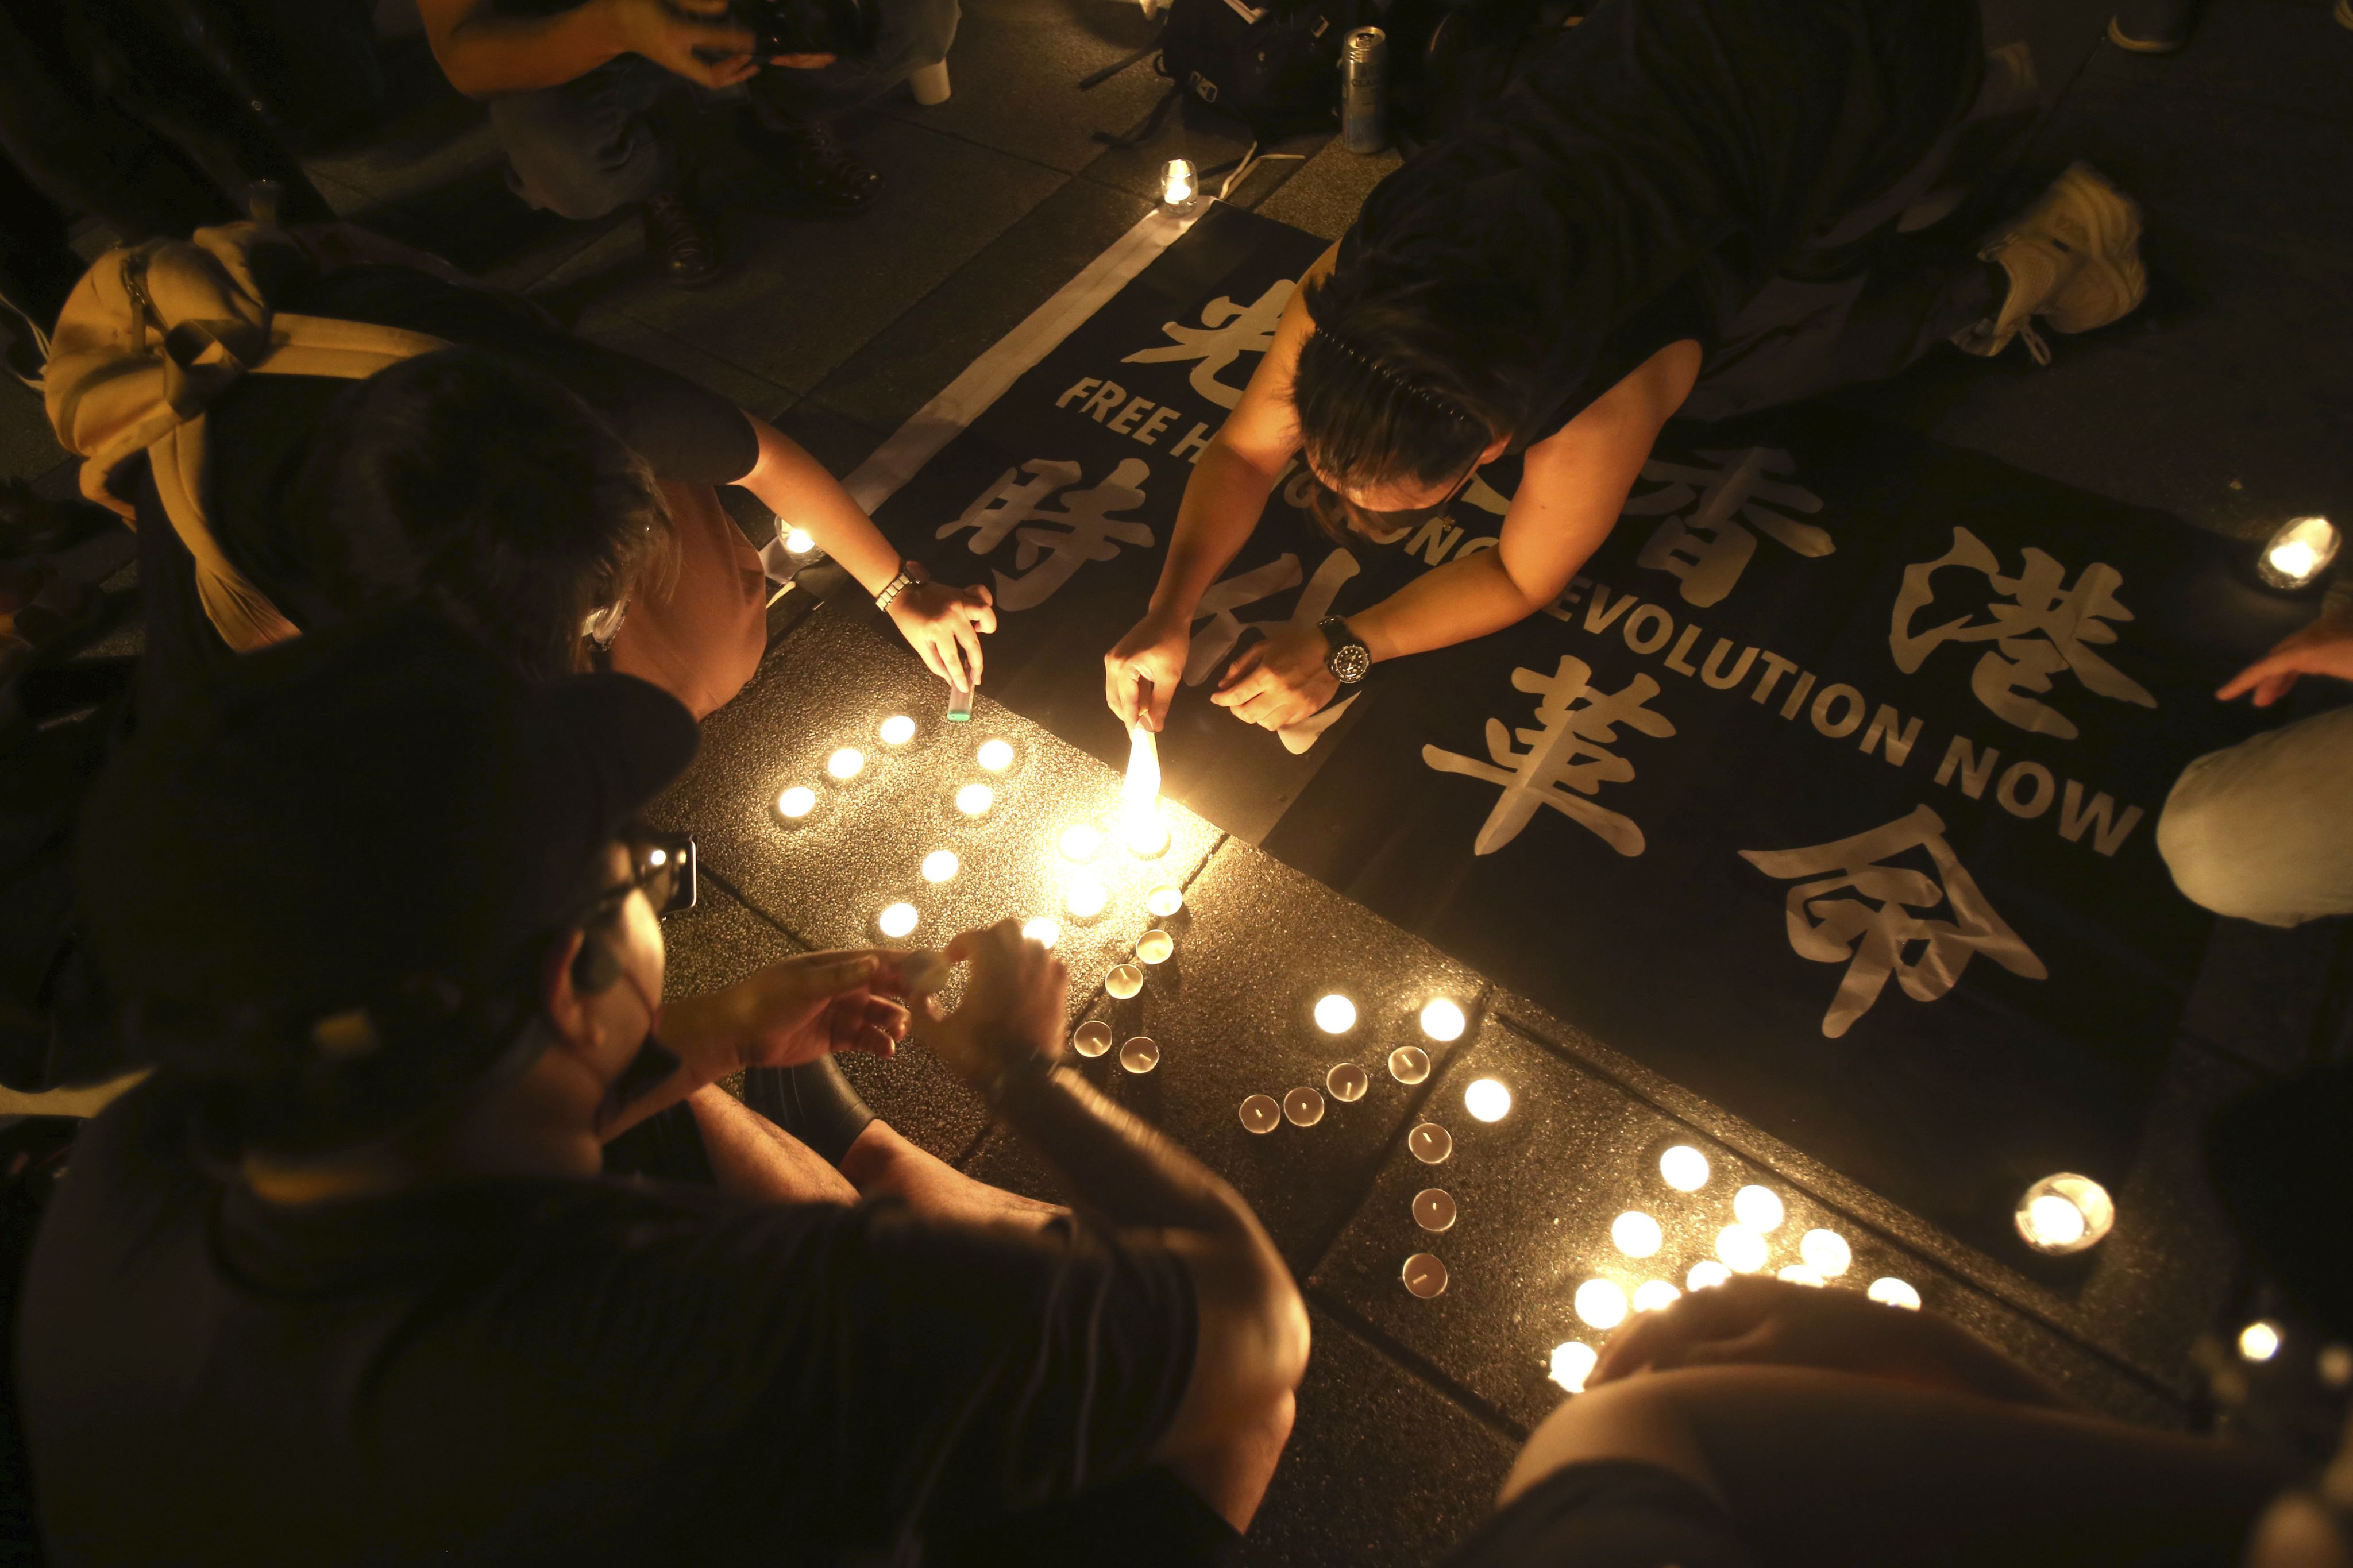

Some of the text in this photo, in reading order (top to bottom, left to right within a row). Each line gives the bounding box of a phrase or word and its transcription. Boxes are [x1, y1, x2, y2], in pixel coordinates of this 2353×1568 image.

[1055, 376, 1182, 446] FREE
[1540, 574, 1924, 768] EVOLUTION
[1934, 735, 2145, 858] NOW
